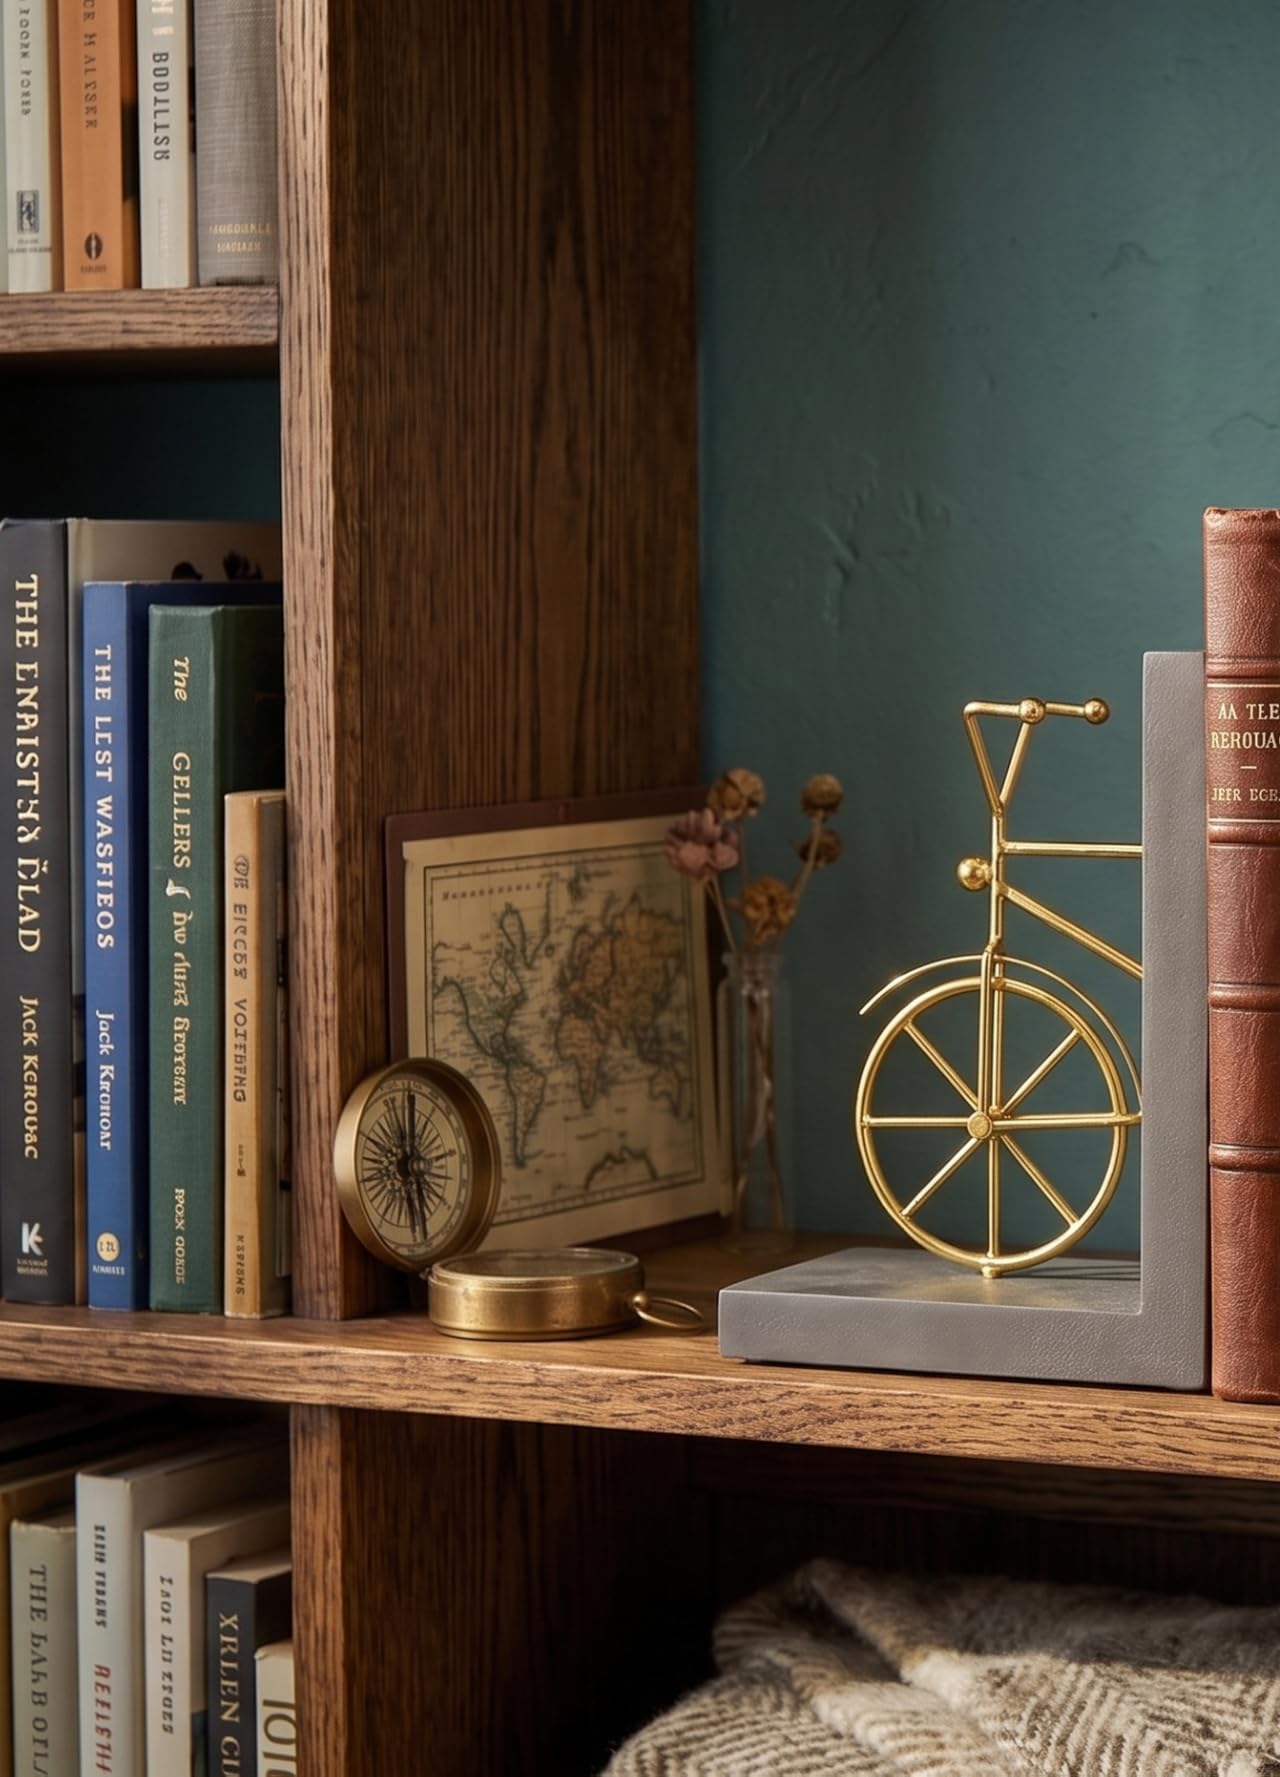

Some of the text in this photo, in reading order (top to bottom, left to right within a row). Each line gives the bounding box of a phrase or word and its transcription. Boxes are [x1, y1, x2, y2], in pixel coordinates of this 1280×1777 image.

[16, 573, 38, 648] THE
[95, 644, 111, 700] THE
[173, 656, 190, 703] The
[171, 751, 191, 869] GELLERS
[19, 994, 39, 1046] JACK
[97, 1009, 114, 1055] Jack
[28, 1563, 48, 1623] THE
